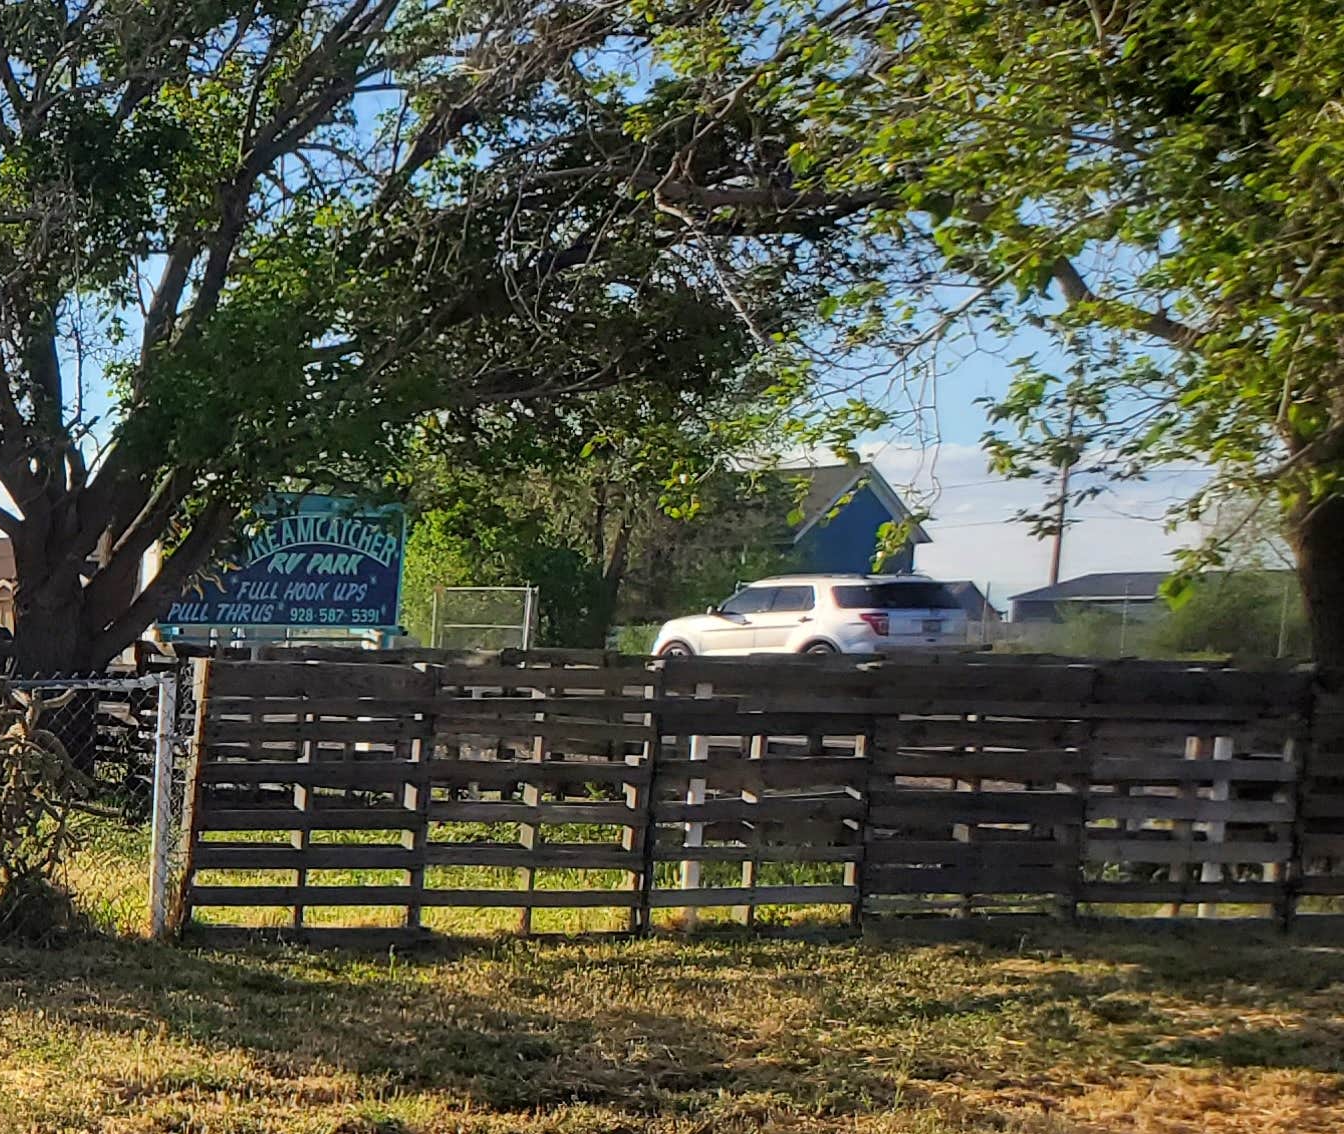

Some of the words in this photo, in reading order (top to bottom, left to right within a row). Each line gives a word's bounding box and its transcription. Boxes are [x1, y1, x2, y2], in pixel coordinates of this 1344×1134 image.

[267, 552, 307, 575] RV
[307, 552, 365, 575] PARK
[236, 581, 280, 601] FULL
[283, 581, 330, 601] HOOK
[332, 582, 368, 602] UPS
[167, 602, 209, 622] PULL
[216, 603, 274, 622] THRUS
